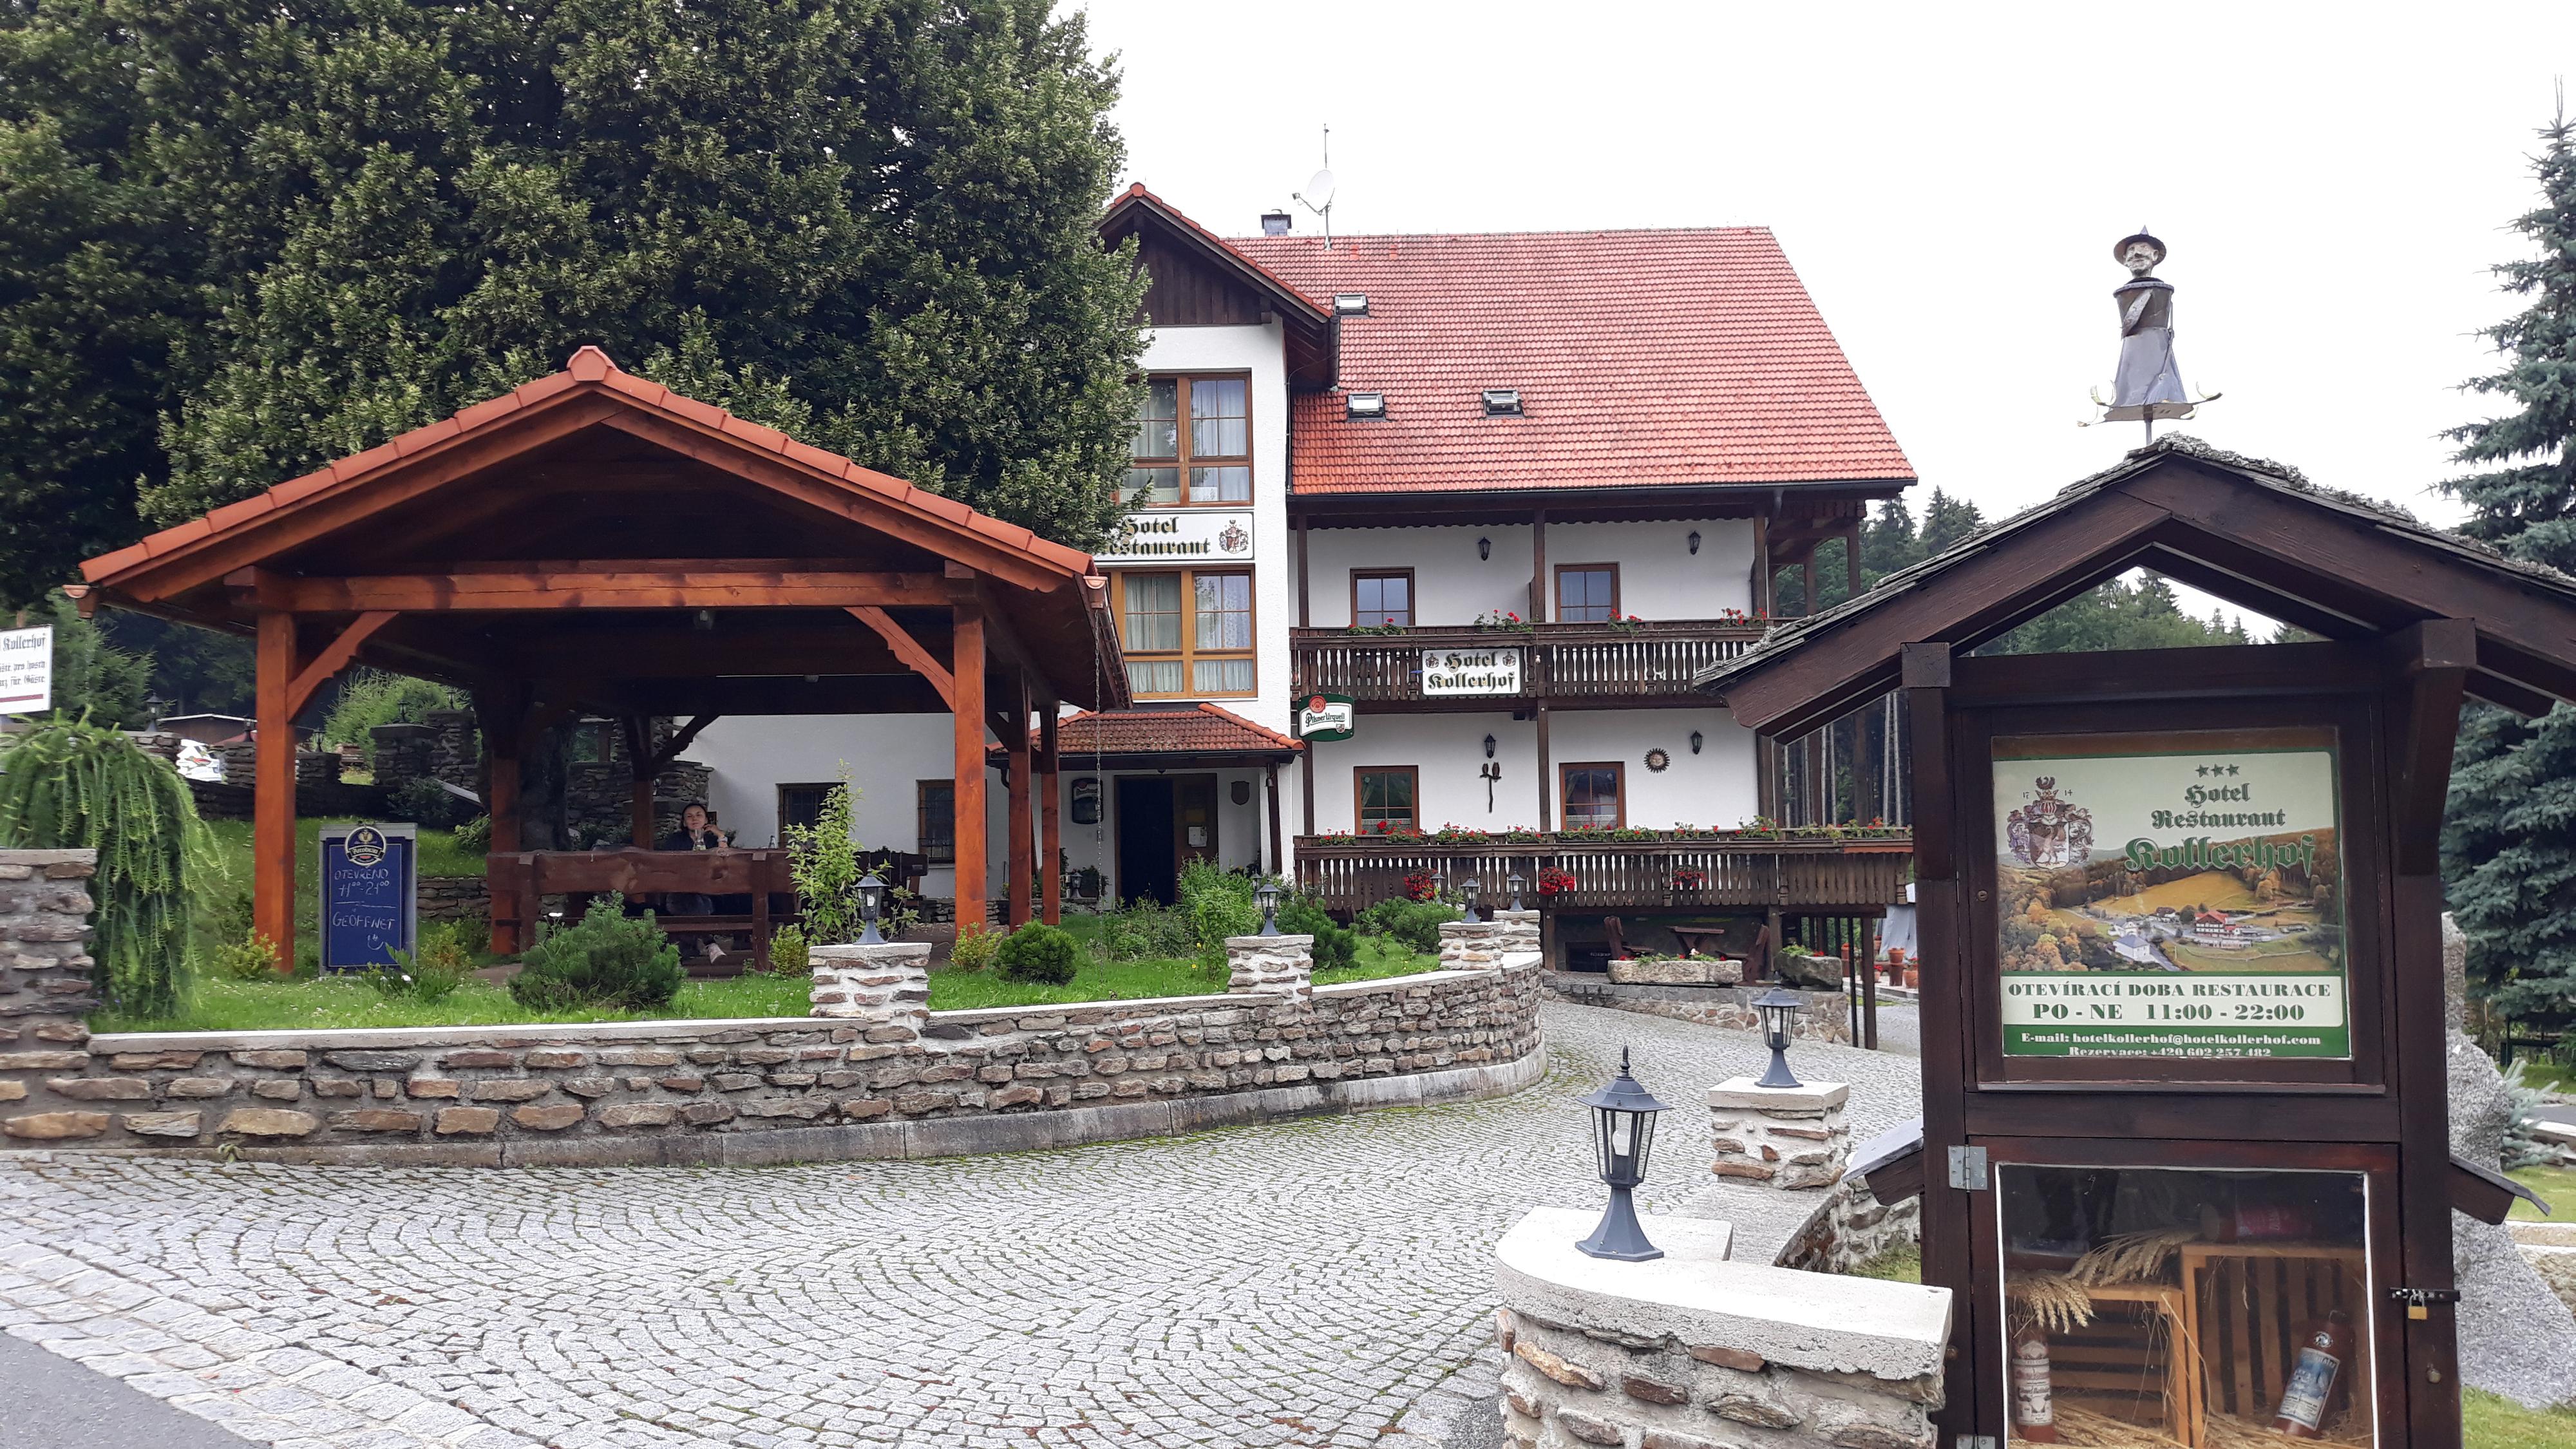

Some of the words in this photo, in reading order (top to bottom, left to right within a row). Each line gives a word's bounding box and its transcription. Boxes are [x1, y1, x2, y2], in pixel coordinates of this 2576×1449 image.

[1121, 516, 1179, 540] Hotel
[1100, 538, 1211, 556] estaurant
[1444, 651, 1498, 672] Hotel
[1428, 671, 1515, 692] Kollerhof
[1305, 713, 1325, 727] Pilsner
[1325, 712, 1345, 723] Urquell
[2184, 782, 2250, 808] Hotel
[2151, 808, 2286, 829] Restaurant
[2125, 835, 2315, 878] Kollerhof
[2008, 981, 2122, 996] OTEVÍRACÍ
[2128, 984, 2185, 996] DOBA
[2192, 984, 2331, 996] RESTAURACE
[2032, 1003, 2069, 1019] PO
[2090, 1004, 2123, 1019] NE
[2145, 1004, 2212, 1020] 11:00
[2235, 1004, 2304, 1020] 22:00
[2022, 1033, 2069, 1043] E-mail:
[2072, 1033, 2321, 1045] hotelkollerhof@hotelkollerhof.com
[2069, 1046, 2147, 1056] Rezervace:
[2150, 1047, 2183, 1056] +420
[2187, 1048, 2212, 1056] 602
[2216, 1048, 2241, 1056] 257
[2246, 1048, 2271, 1056] 482
